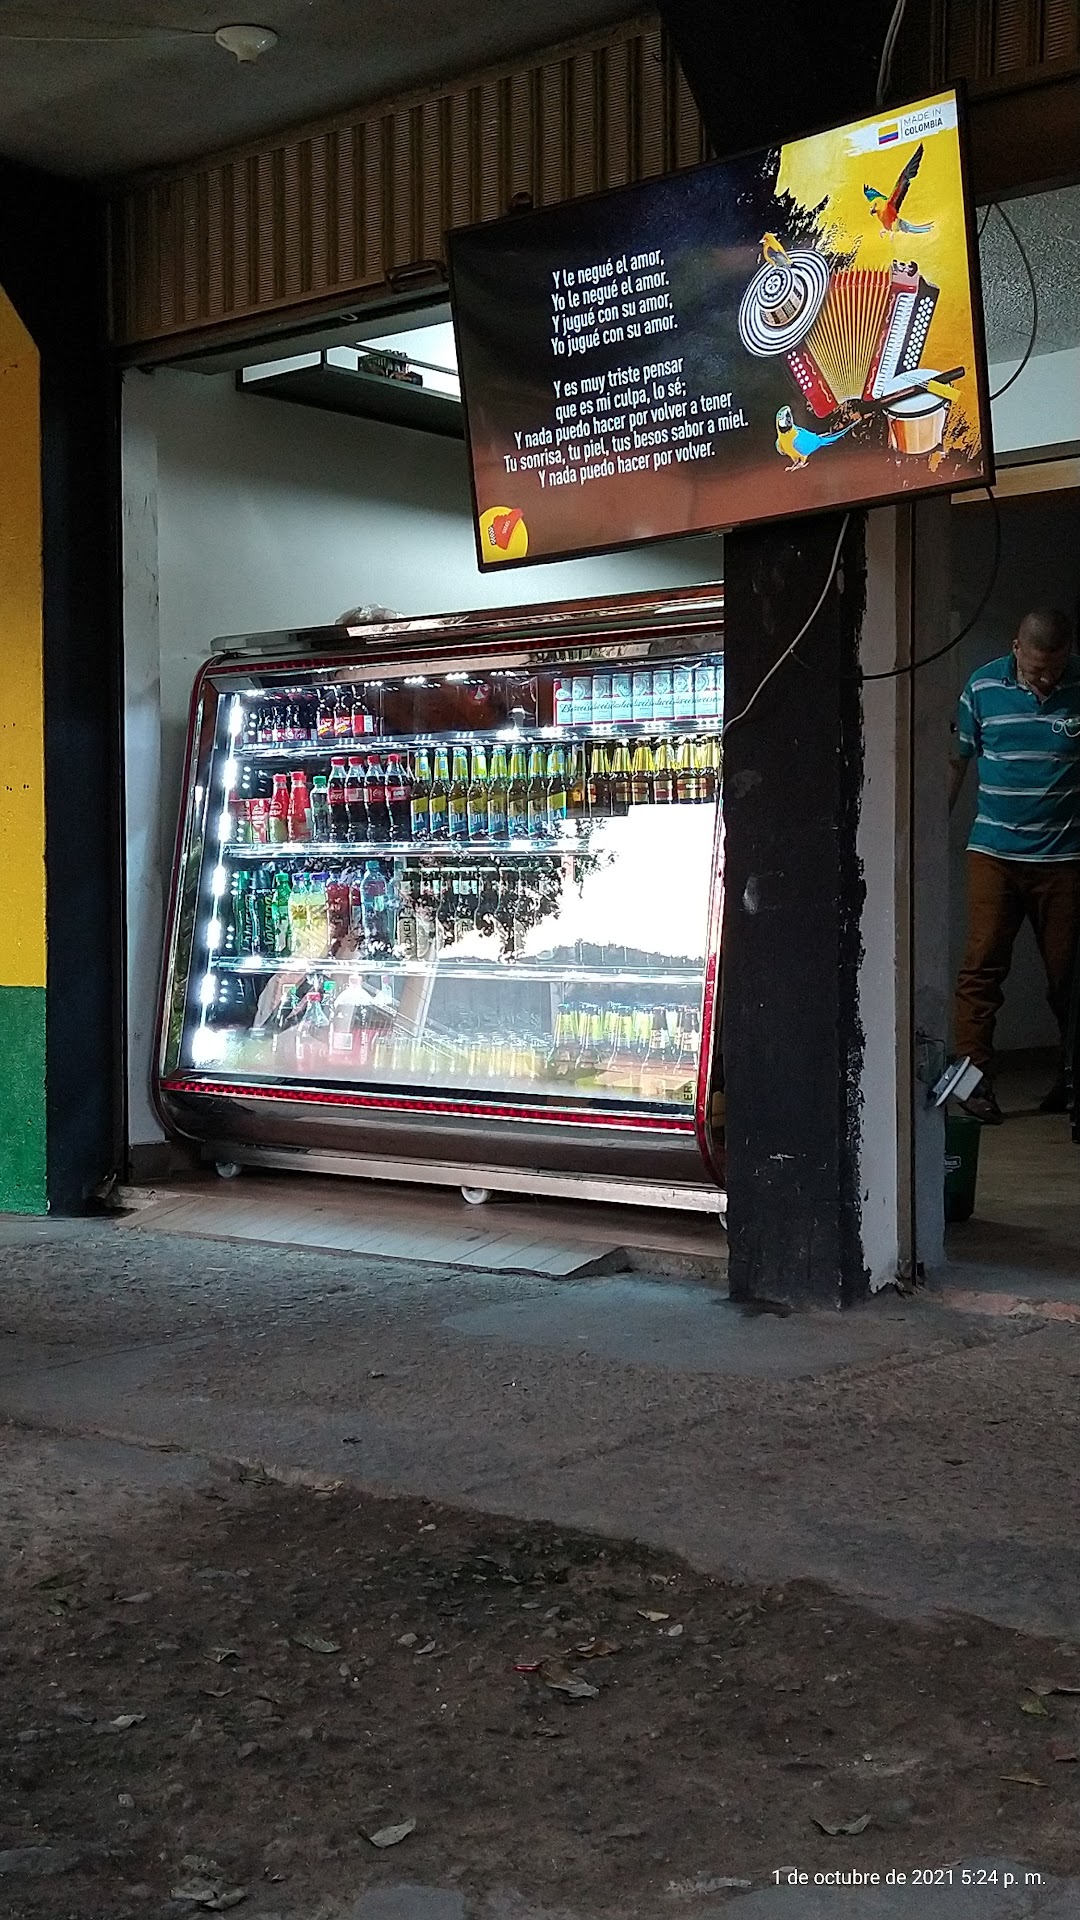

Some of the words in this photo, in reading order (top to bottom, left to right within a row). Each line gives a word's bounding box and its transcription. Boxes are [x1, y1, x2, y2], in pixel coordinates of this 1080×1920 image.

[903, 112, 929, 125] MADE
[932, 108, 942, 116] IN
[904, 118, 943, 136] COLOMBIA
[552, 271, 560, 289] Y
[563, 269, 575, 287] le
[578, 258, 613, 284] negué
[616, 255, 628, 274] el
[630, 250, 664, 270] amor,
[551, 293, 565, 311] Yo
[568, 290, 580, 307] le
[583, 279, 618, 305] negué
[621, 276, 633, 295] el
[635, 272, 669, 291] amor.
[551, 337, 564, 355] Yo
[567, 328, 600, 357] jugué
[603, 327, 624, 344] con
[627, 323, 641, 338] su
[644, 315, 677, 334] amor.
[552, 315, 559, 333] Y
[562, 307, 595, 338] jugué
[598, 306, 619, 323] con
[622, 302, 636, 317] su
[639, 293, 672, 313] amor,
[553, 381, 560, 398] Y
[564, 382, 578, 396] es
[581, 375, 605, 394] muy
[608, 366, 640, 387] triste
[643, 358, 683, 384] pensar
[514, 431, 522, 449] Y
[525, 427, 552, 448] nada
[556, 420, 590, 446] puedo
[593, 415, 626, 434] hacer
[629, 410, 648, 432] por
[650, 402, 687, 423] volver
[690, 401, 698, 414] a
[700, 393, 732, 415] tener
[556, 404, 577, 424] que
[580, 400, 593, 415] es
[596, 392, 611, 412] mi
[614, 388, 650, 409] culpa,
[653, 382, 665, 400] lo
[668, 377, 686, 396] sé;
[504, 455, 517, 473] Tu
[520, 448, 565, 470] sonrisa,
[568, 444, 581, 460] tu
[584, 437, 609, 463] piel,
[612, 436, 631, 452] tus
[634, 429, 668, 449] besos
[671, 420, 704, 441] sabor
[707, 419, 714, 433] a
[718, 409, 748, 431] miel.
[538, 470, 545, 488] Y
[549, 465, 577, 486] nada
[580, 458, 614, 486] puedo
[617, 454, 650, 473] hacer
[653, 450, 672, 471] por
[675, 442, 715, 462] volver.
